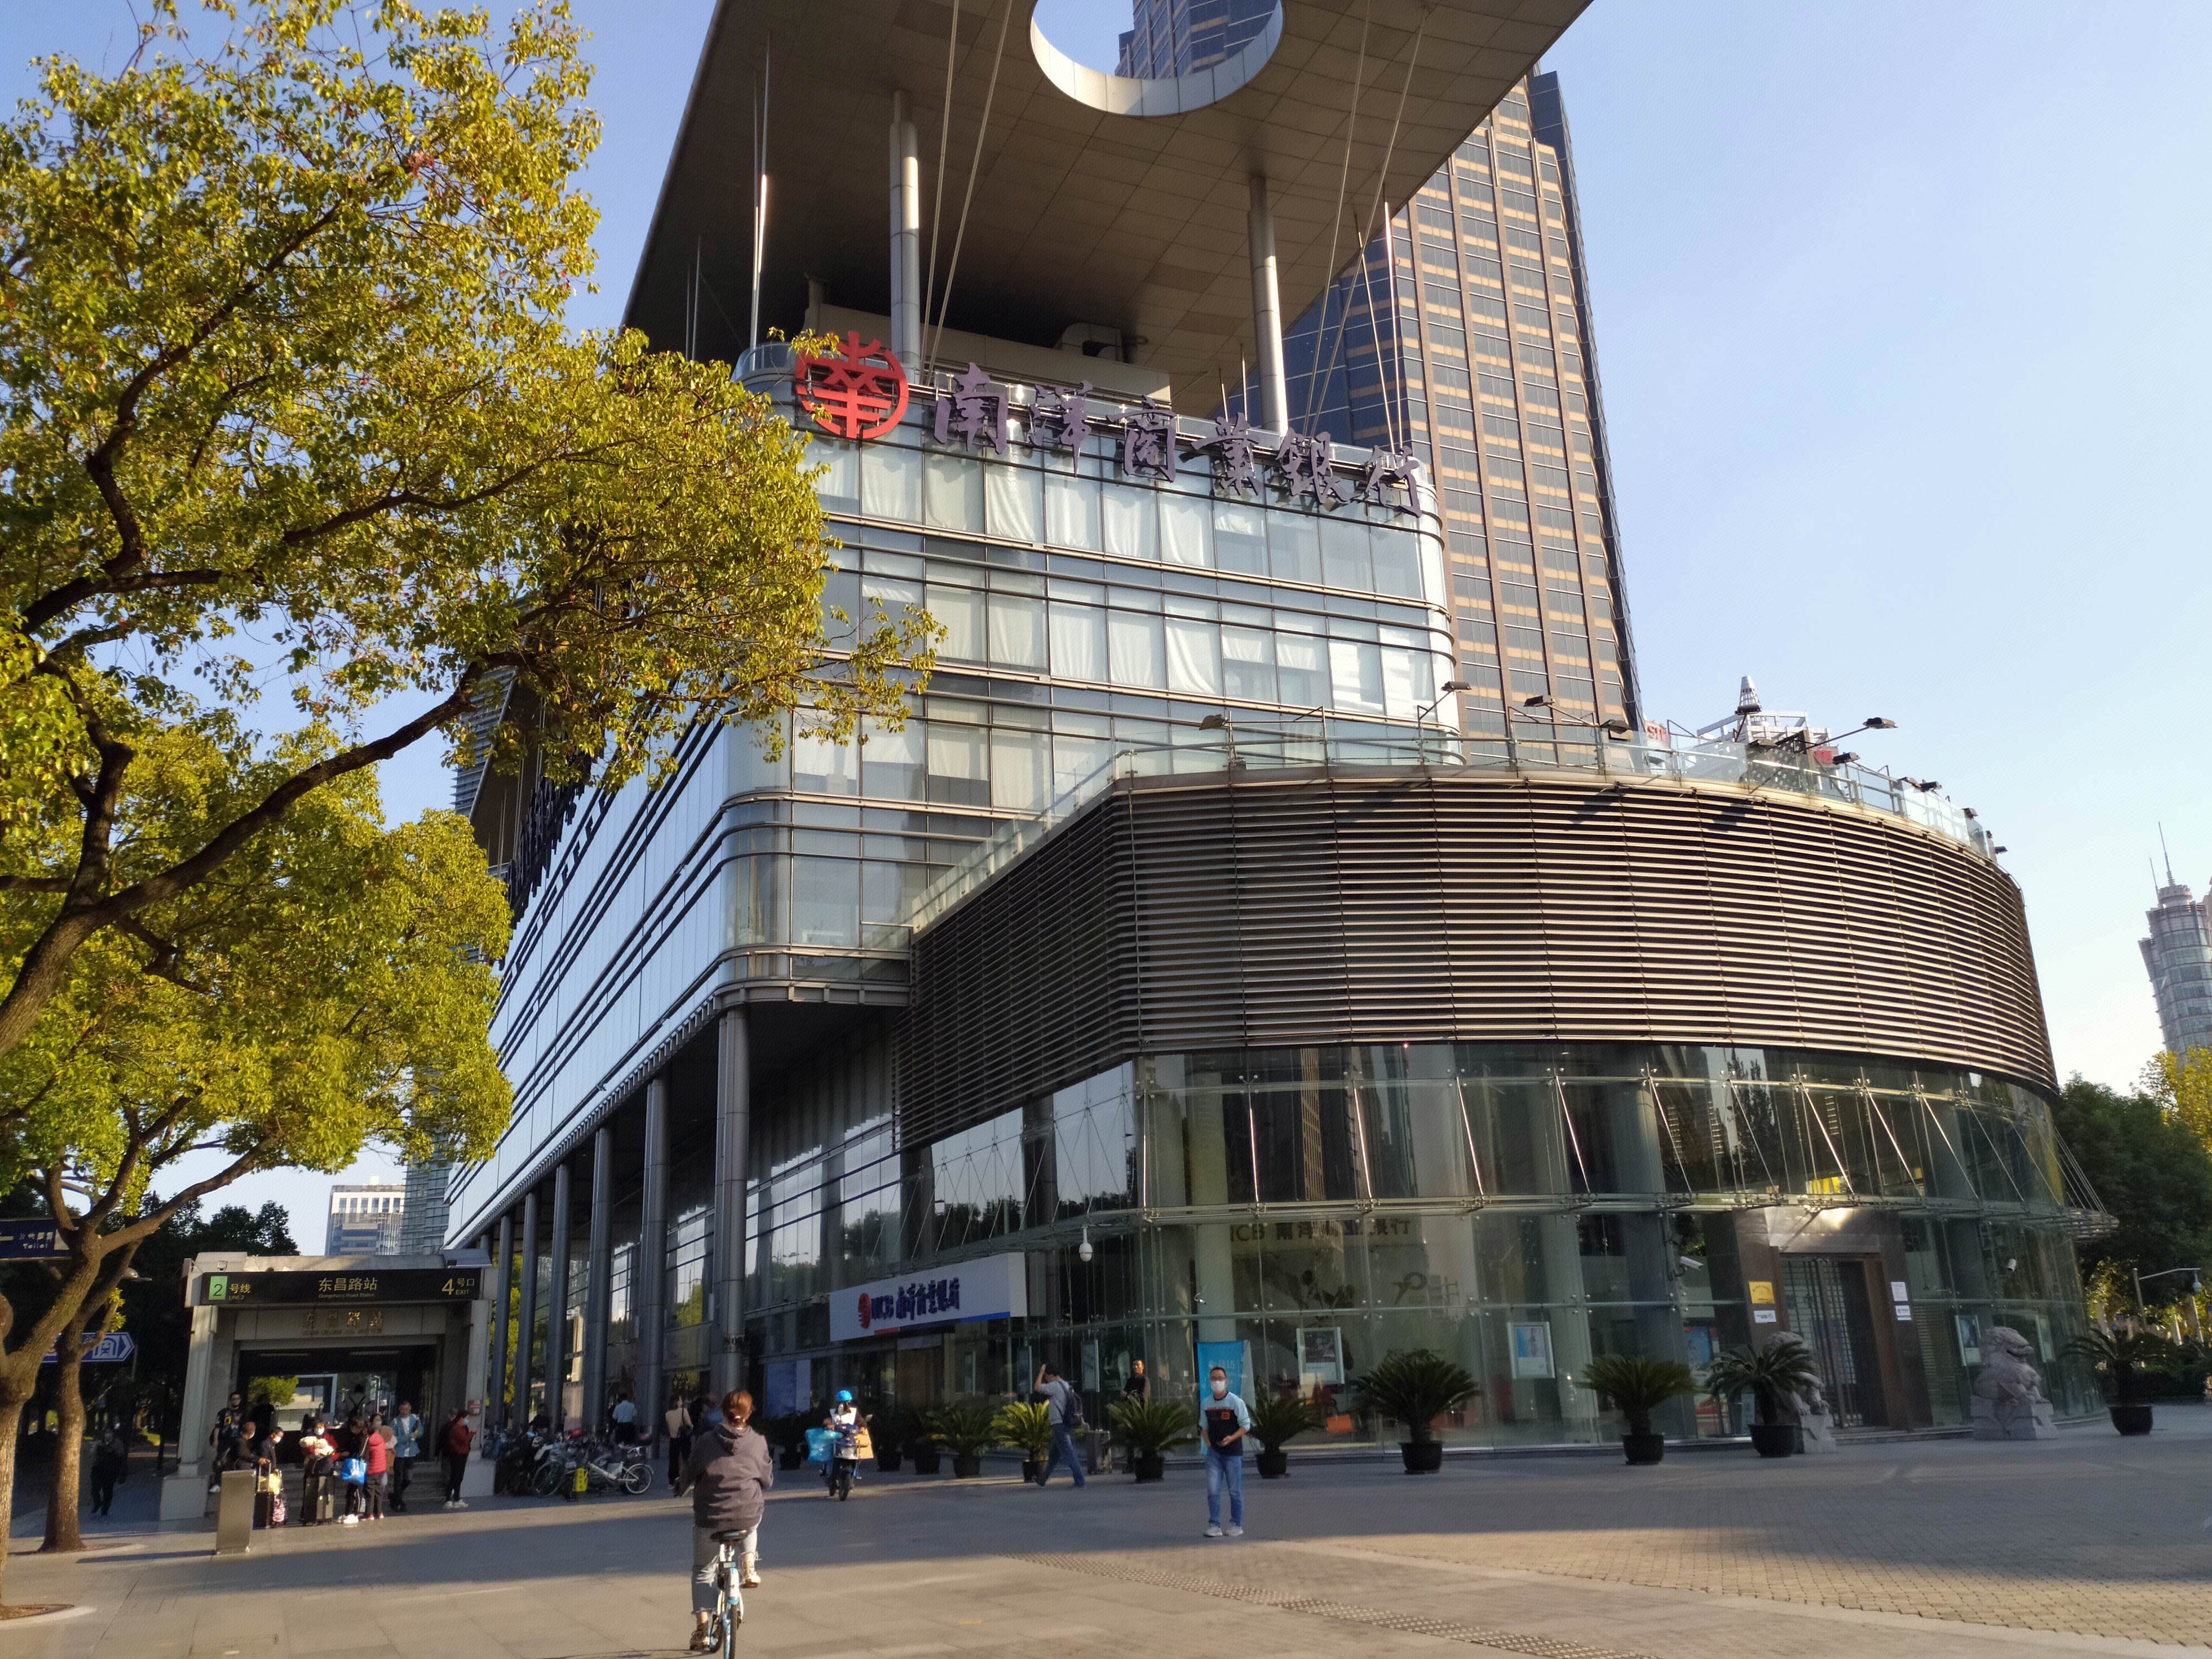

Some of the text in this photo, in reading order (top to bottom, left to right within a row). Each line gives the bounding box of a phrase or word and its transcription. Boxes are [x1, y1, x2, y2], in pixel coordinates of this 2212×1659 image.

[319, 1277, 378, 1292] 东昌路站
[442, 1278, 454, 1295] 4
[457, 1277, 474, 1287] 号口
[212, 1284, 223, 1297] 2
[229, 1284, 251, 1294] 号线
